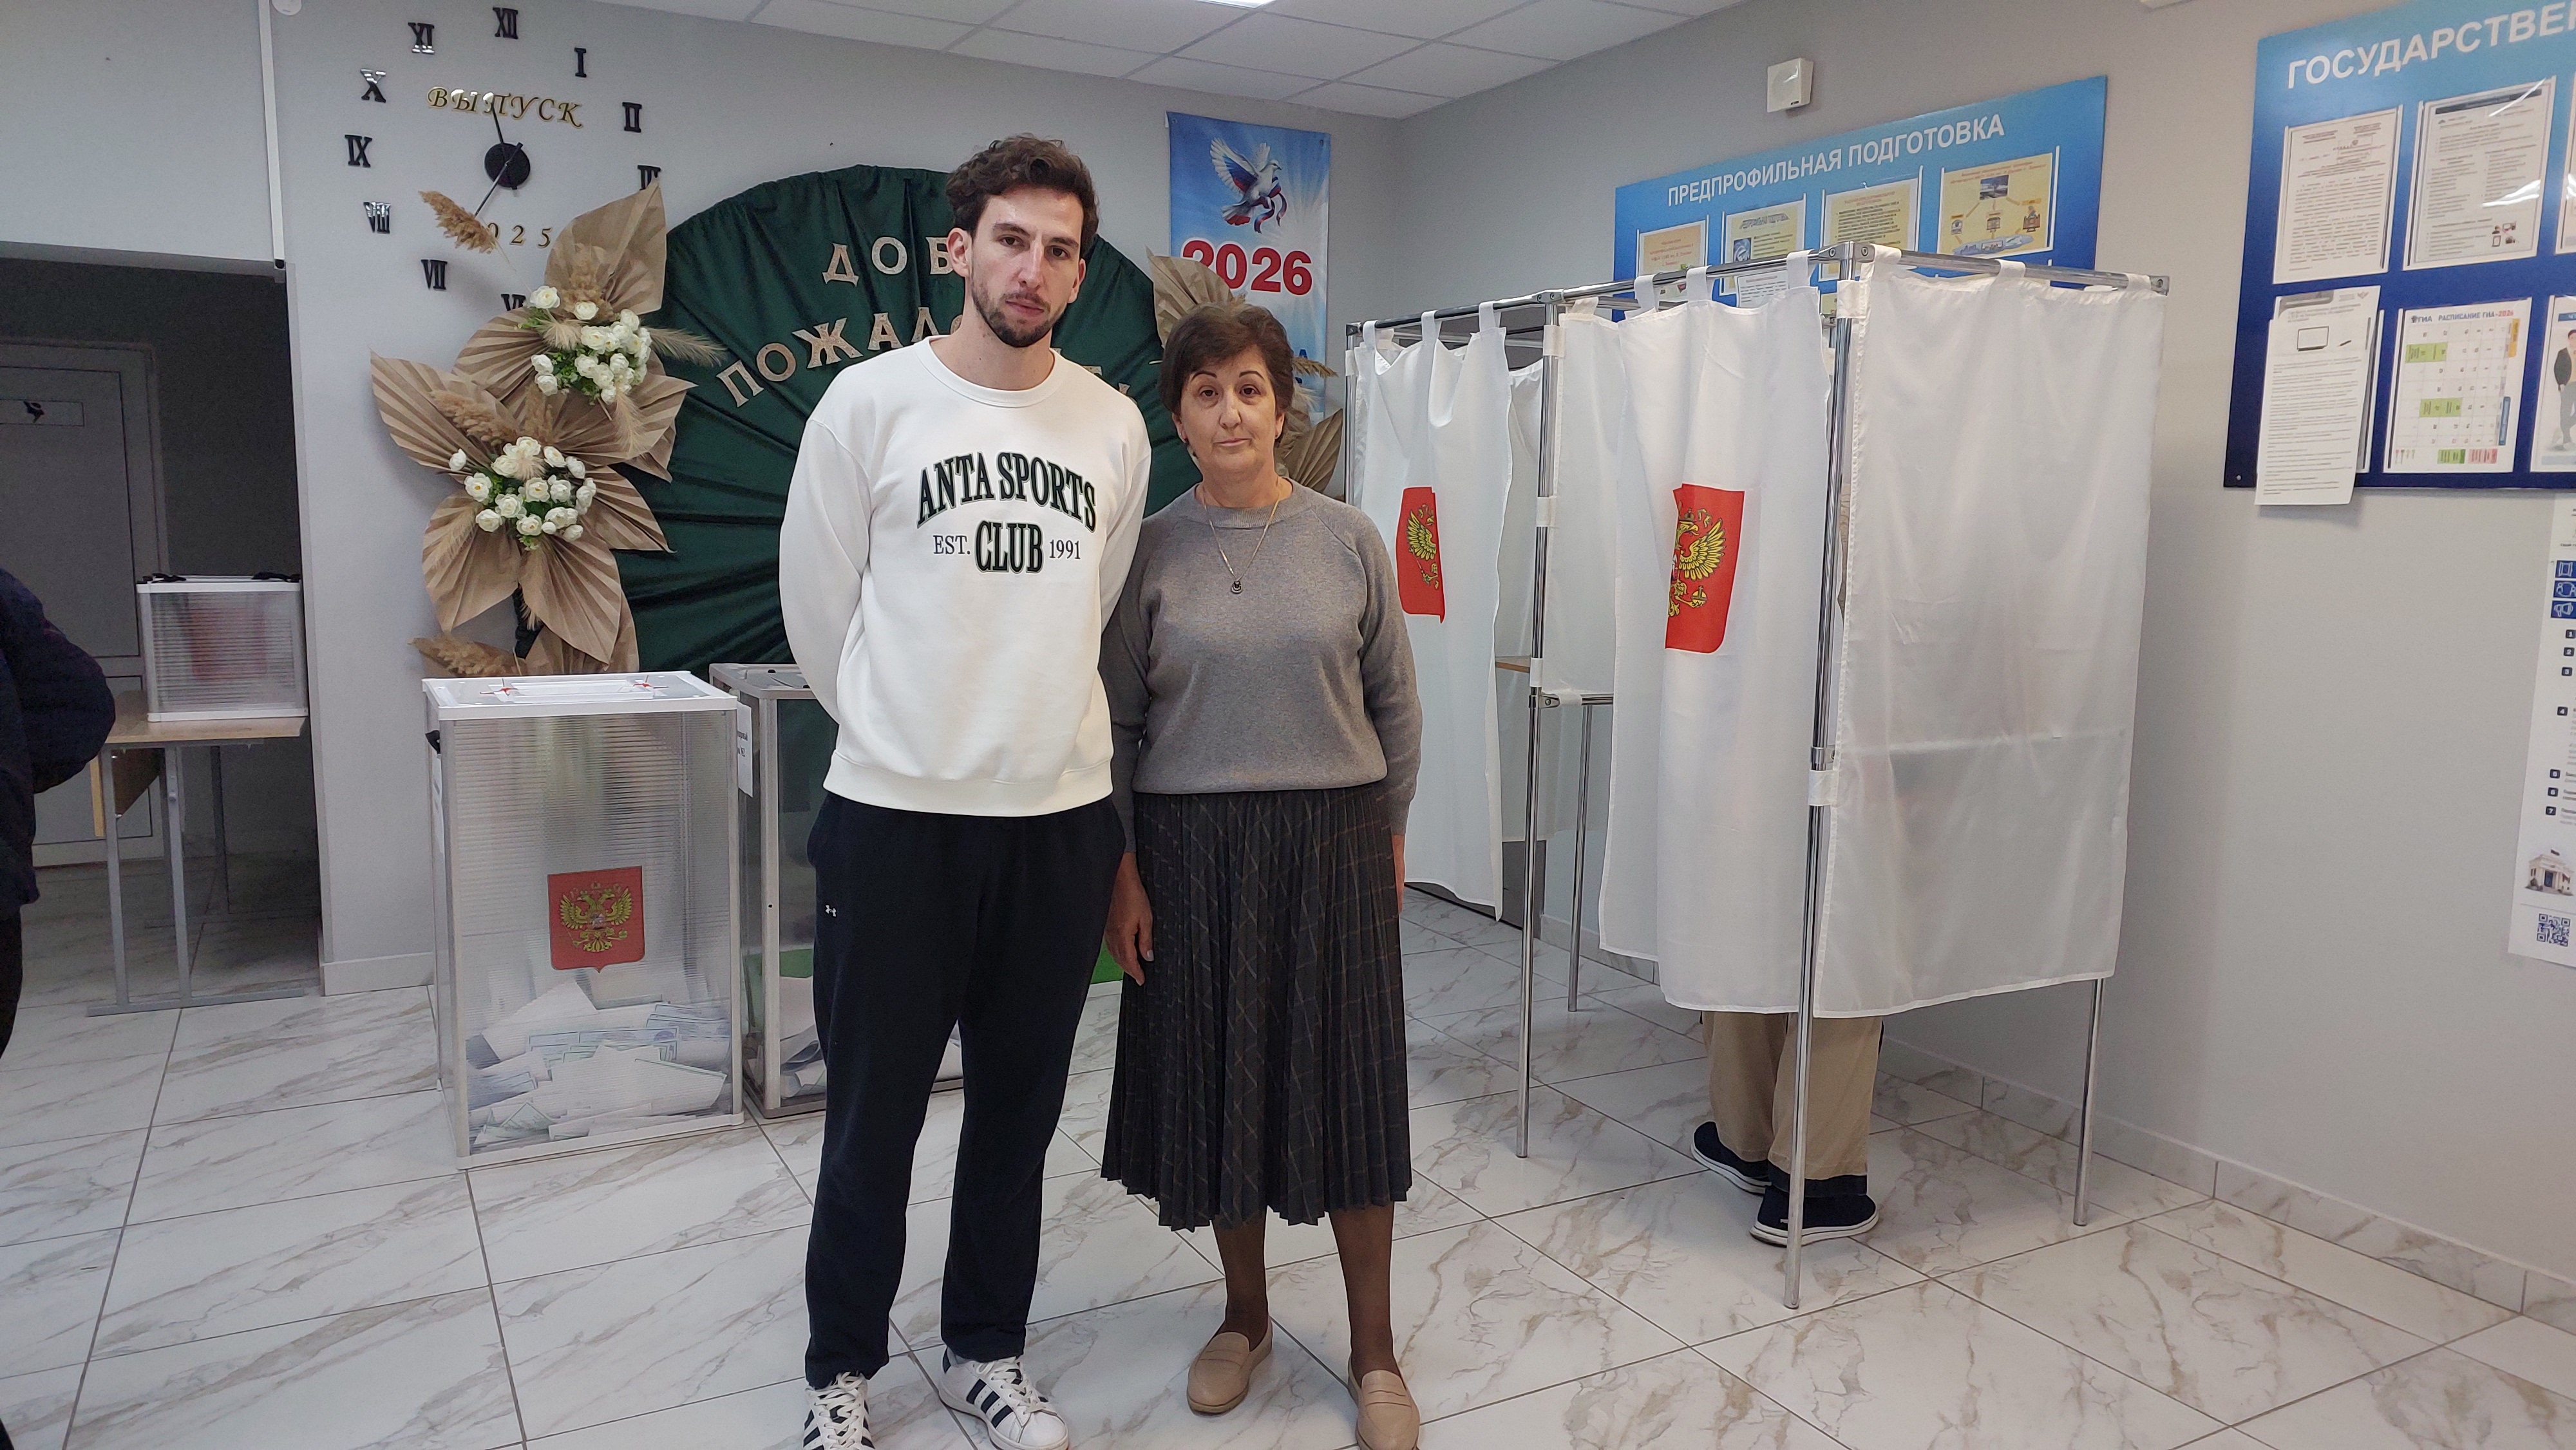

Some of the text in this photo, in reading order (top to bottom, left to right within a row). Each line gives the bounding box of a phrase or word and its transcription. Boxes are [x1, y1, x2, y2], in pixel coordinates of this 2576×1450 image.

[408, 22, 435, 55] XI
[493, 7, 518, 39] XII
[2287, 0, 2576, 89] ГОСУДАРСТВЕ
[574, 47, 587, 78] I
[360, 69, 386, 103] X
[427, 86, 583, 129] ВЫПУСК
[622, 102, 642, 133] II
[345, 135, 372, 167] IX
[1668, 113, 2005, 207] ПРЕДПРОФИЛЬНАЯ ПОДГОТОВКА
[363, 202, 391, 234] VIII
[421, 259, 448, 290] VII
[822, 236, 954, 287] ДОБ
[2438, 312, 2481, 321] РАСПИСАНИЕ
[916, 451, 1096, 533] ANTA SPORTS
[933, 520, 1081, 574] EST. CLUB 1991
